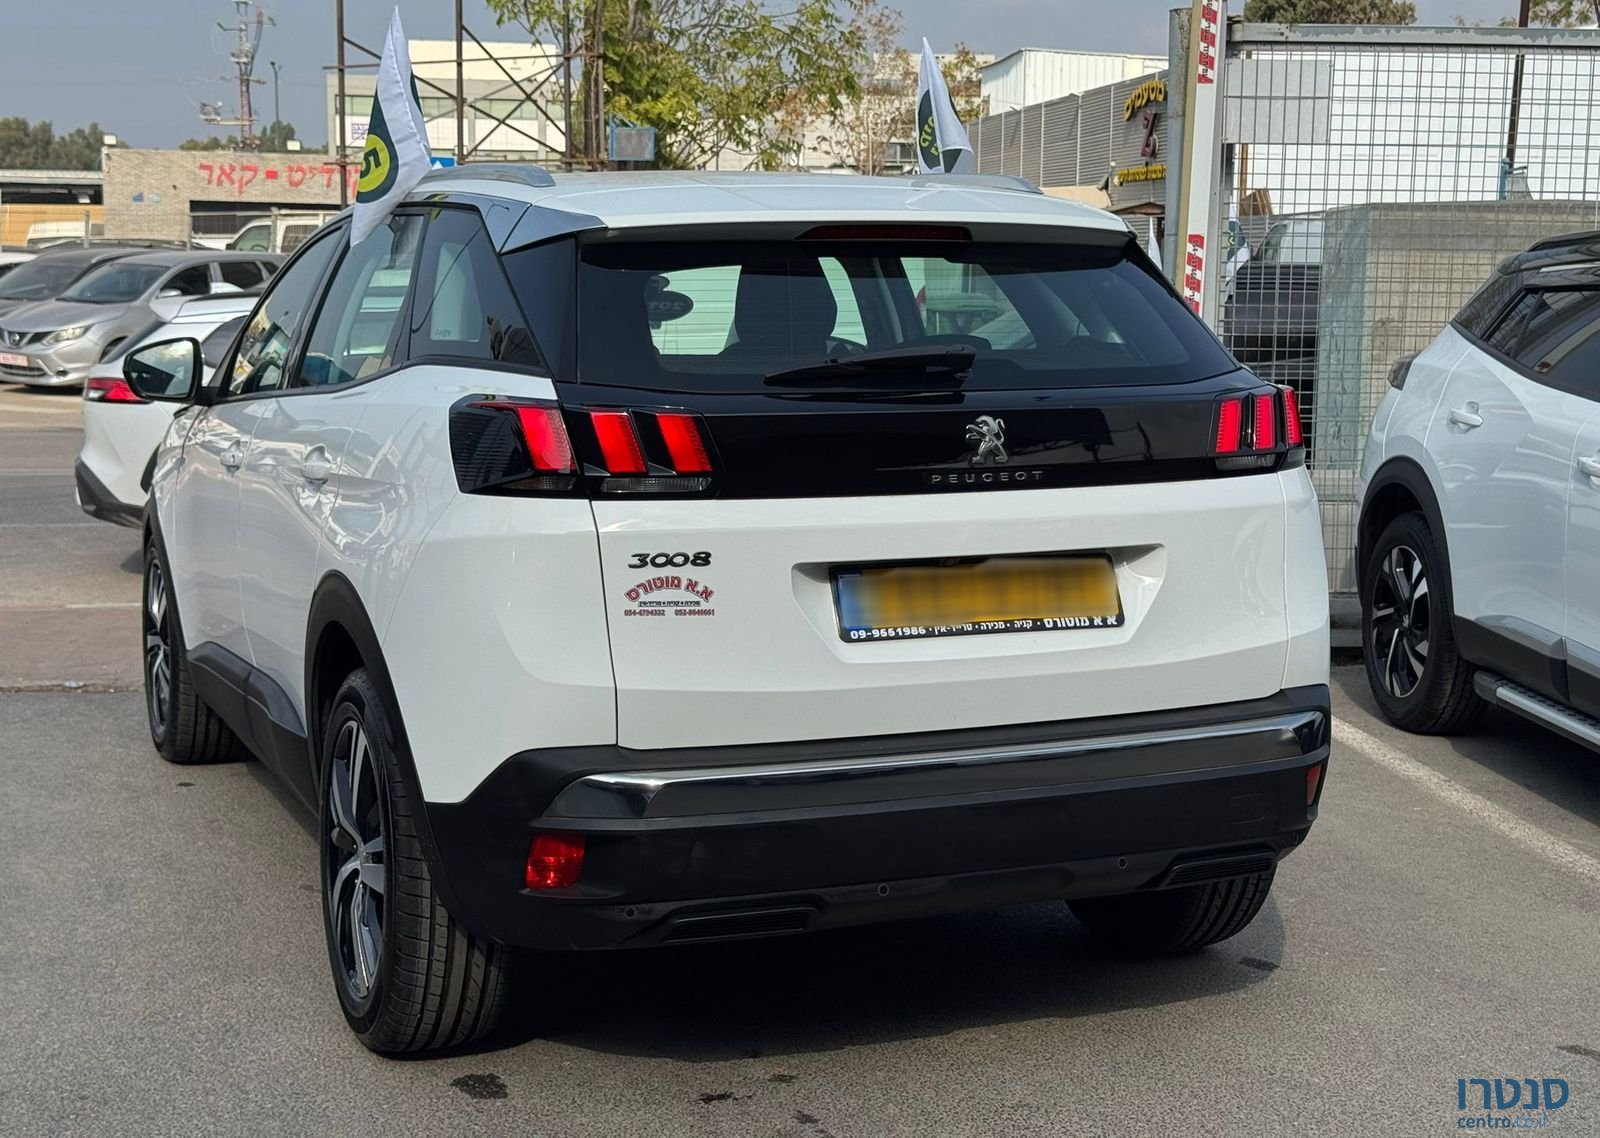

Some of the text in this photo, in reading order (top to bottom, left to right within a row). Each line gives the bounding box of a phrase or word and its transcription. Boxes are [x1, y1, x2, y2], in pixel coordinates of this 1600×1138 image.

[198, 161, 260, 197] קאר
[931, 471, 1044, 484] PEUGEOT
[627, 551, 712, 569] 3008
[624, 575, 715, 603] א.א מוטורס
[980, 620, 1006, 630] מכירה
[1013, 619, 1033, 629] קניה
[1043, 616, 1090, 629] מוטורס
